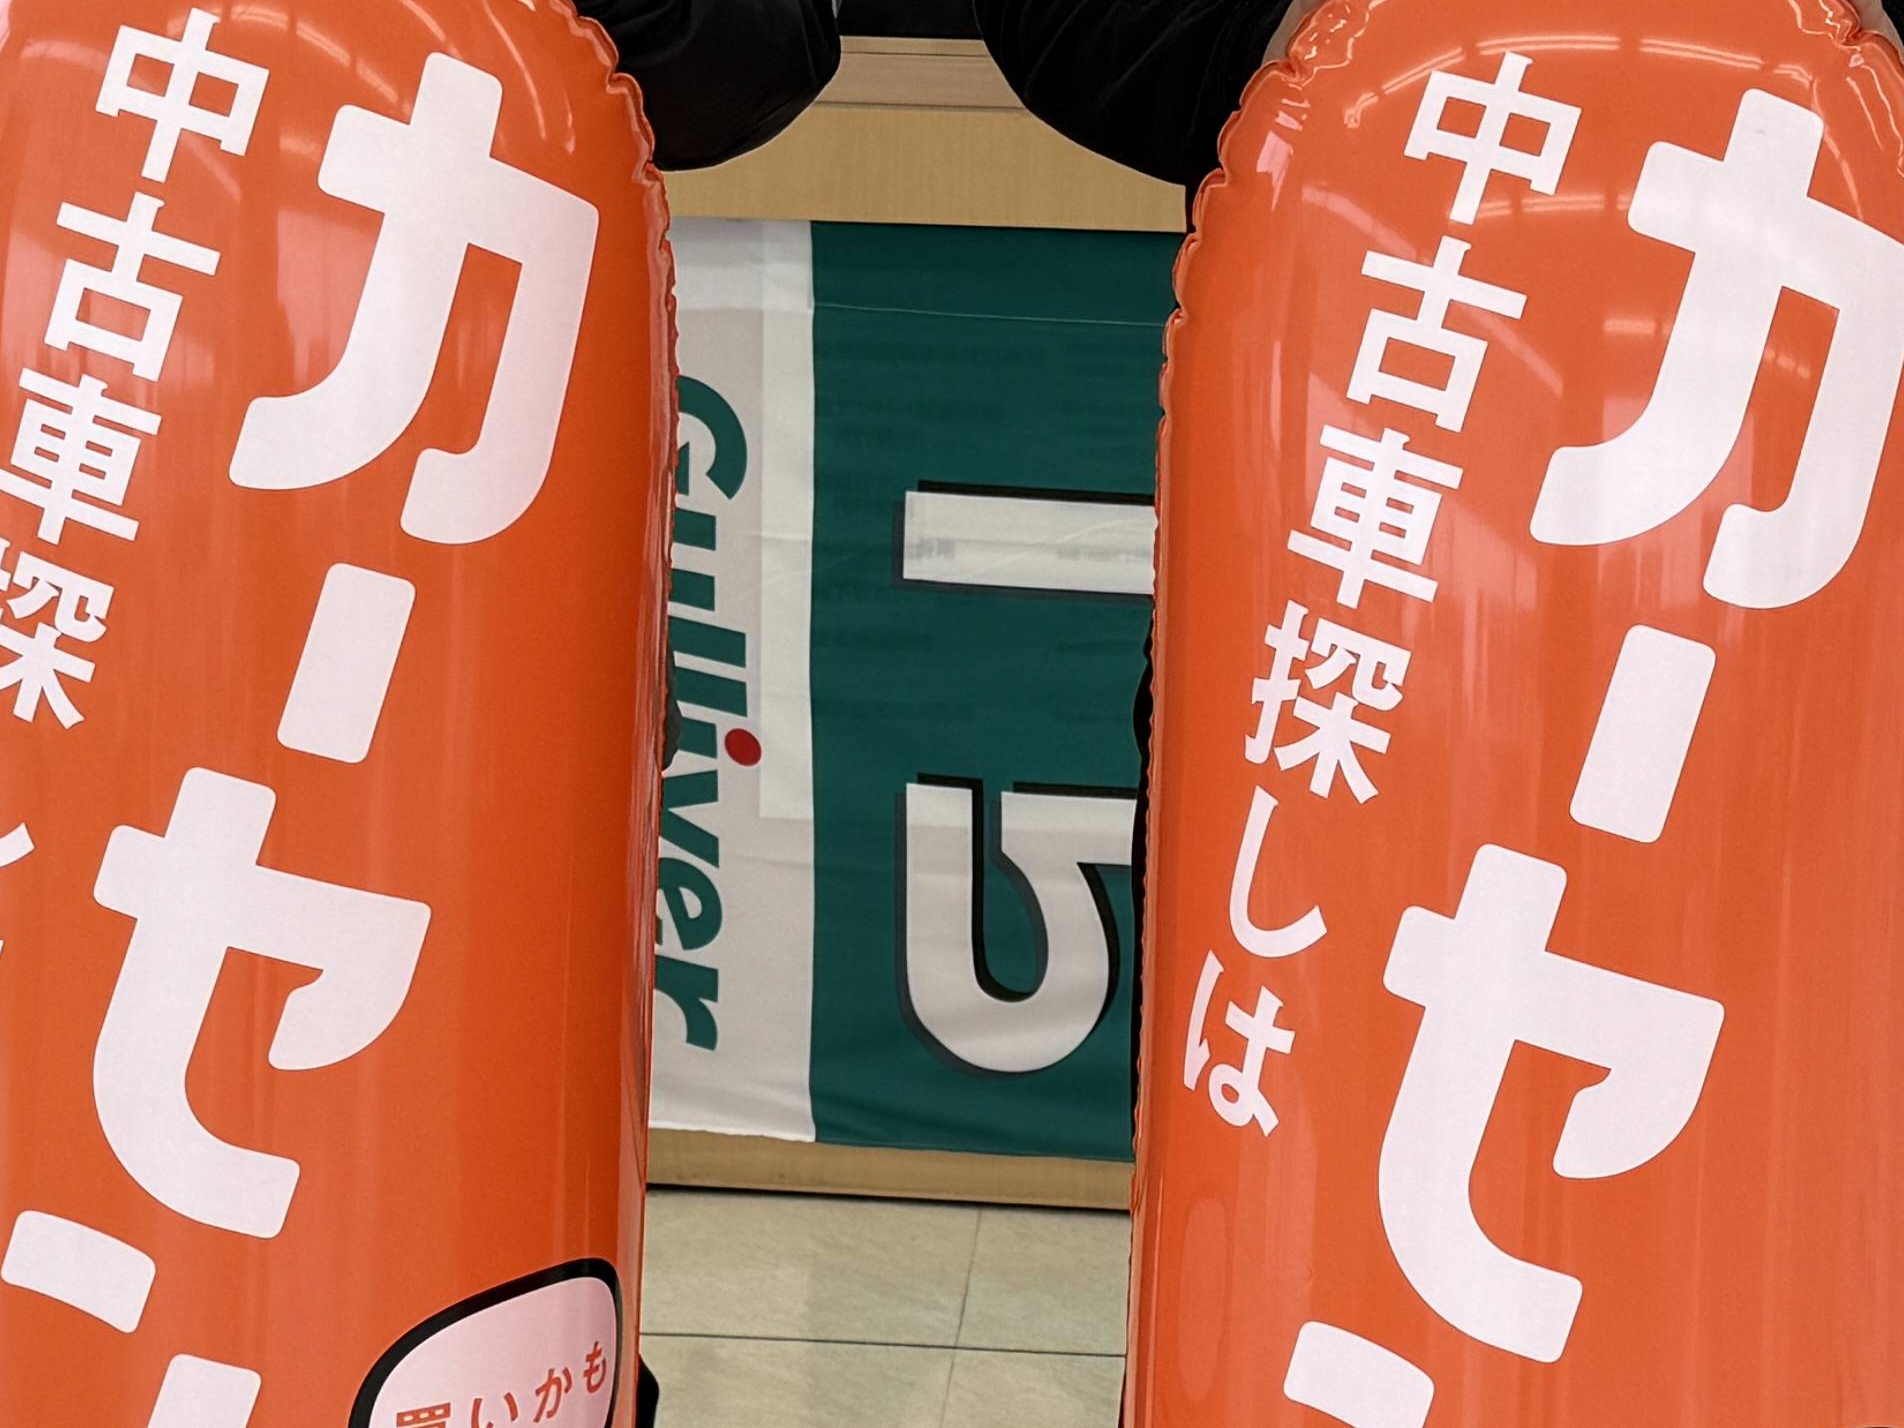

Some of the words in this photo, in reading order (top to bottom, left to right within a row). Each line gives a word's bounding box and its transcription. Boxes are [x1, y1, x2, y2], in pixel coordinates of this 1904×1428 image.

[1182, 49, 1583, 1138] 中古車探しは
